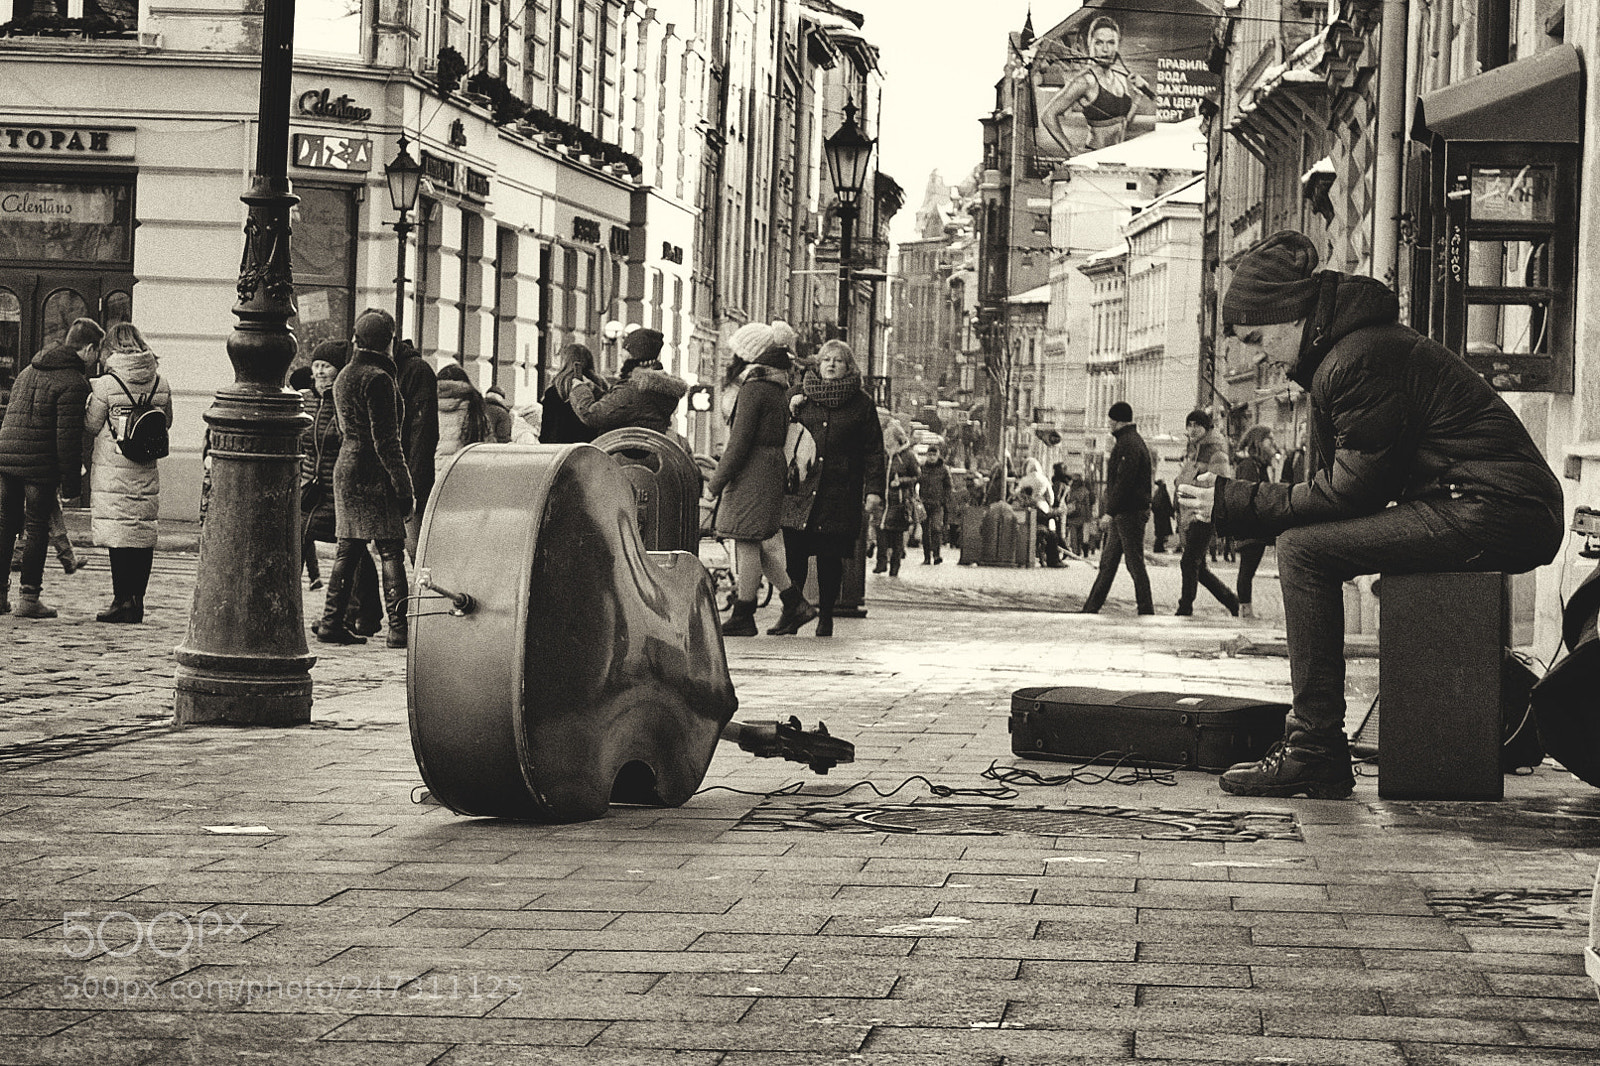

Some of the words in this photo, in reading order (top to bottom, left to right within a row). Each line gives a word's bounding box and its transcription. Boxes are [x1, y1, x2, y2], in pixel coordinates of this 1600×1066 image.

[1157, 70, 1188, 83] ВОДА
[1156, 96, 1171, 108] ЗА
[0, 128, 109, 152] ТОРАН
[2, 192, 73, 215] Celentano
